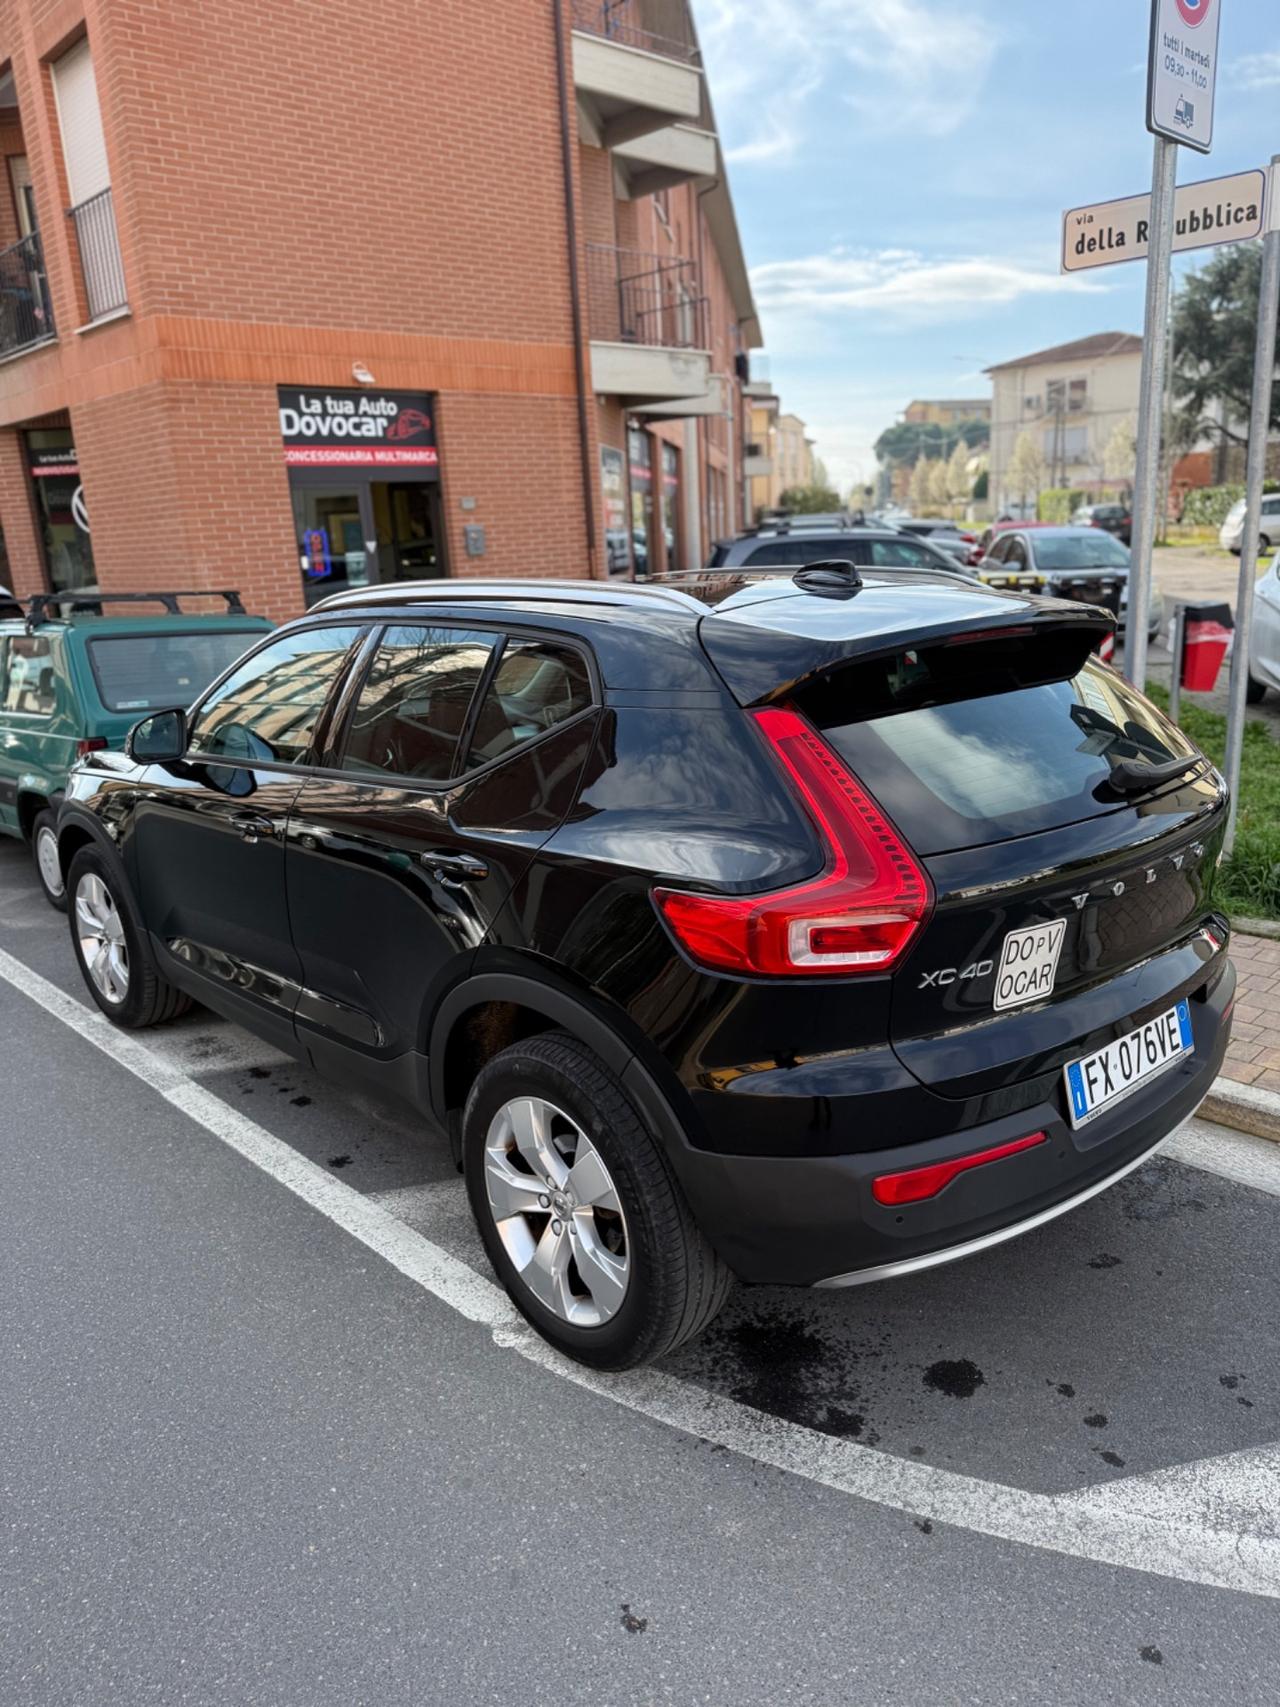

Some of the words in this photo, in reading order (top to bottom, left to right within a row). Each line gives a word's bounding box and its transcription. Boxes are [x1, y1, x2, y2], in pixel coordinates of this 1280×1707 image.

[1164, 32, 1180, 53] tutti
[1075, 229, 1126, 255] della
[1136, 203, 1258, 243] Rubblica
[1076, 213, 1094, 225] via
[299, 394, 322, 414] La
[325, 396, 355, 415] tua
[358, 396, 398, 416] Auto
[279, 408, 388, 437] Dovocar
[1071, 841, 1204, 910] VOLVO
[999, 963, 1052, 1000] OCAR
